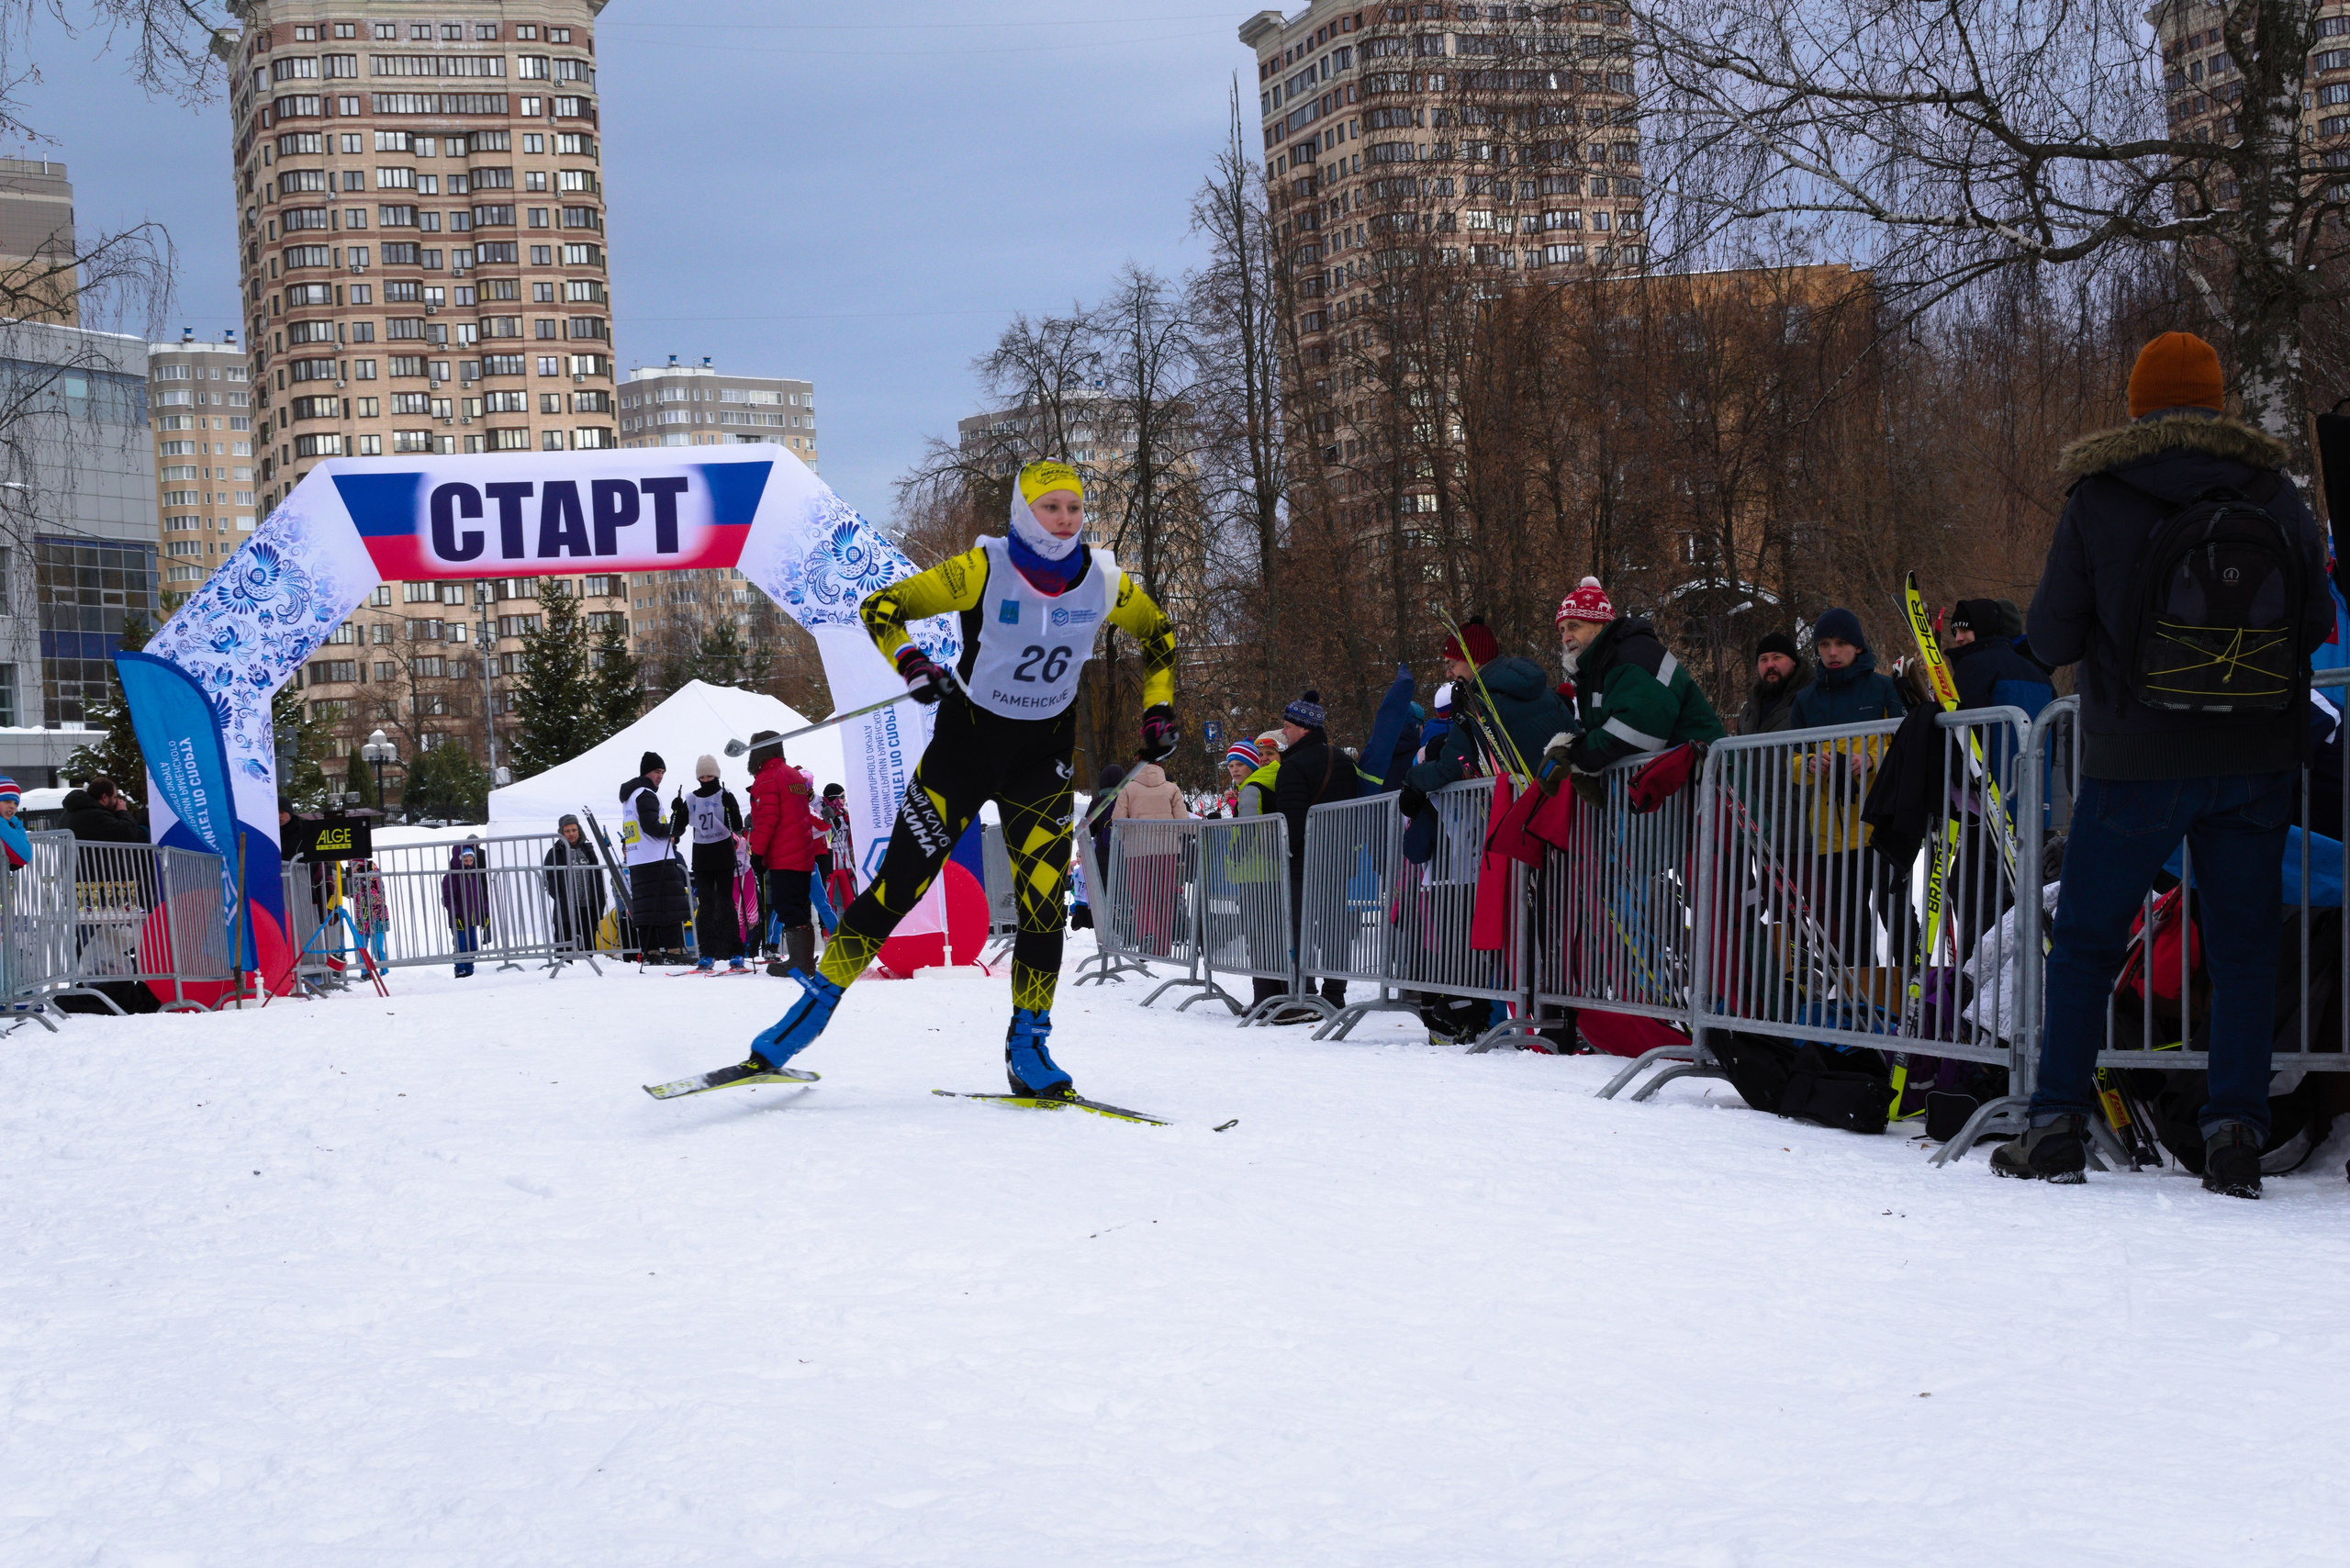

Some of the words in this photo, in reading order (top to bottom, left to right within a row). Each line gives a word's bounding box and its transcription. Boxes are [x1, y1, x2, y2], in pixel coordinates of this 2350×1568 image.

[430, 476, 688, 562] СТАРТ
[1013, 644, 1072, 684] 26
[1910, 599, 1943, 666] CHER
[317, 828, 352, 844] ALGE
[699, 812, 713, 831] 27
[901, 795, 937, 858] АКИНА
[909, 777, 931, 808] НЫЙ
[922, 809, 952, 848] КЛУБ
